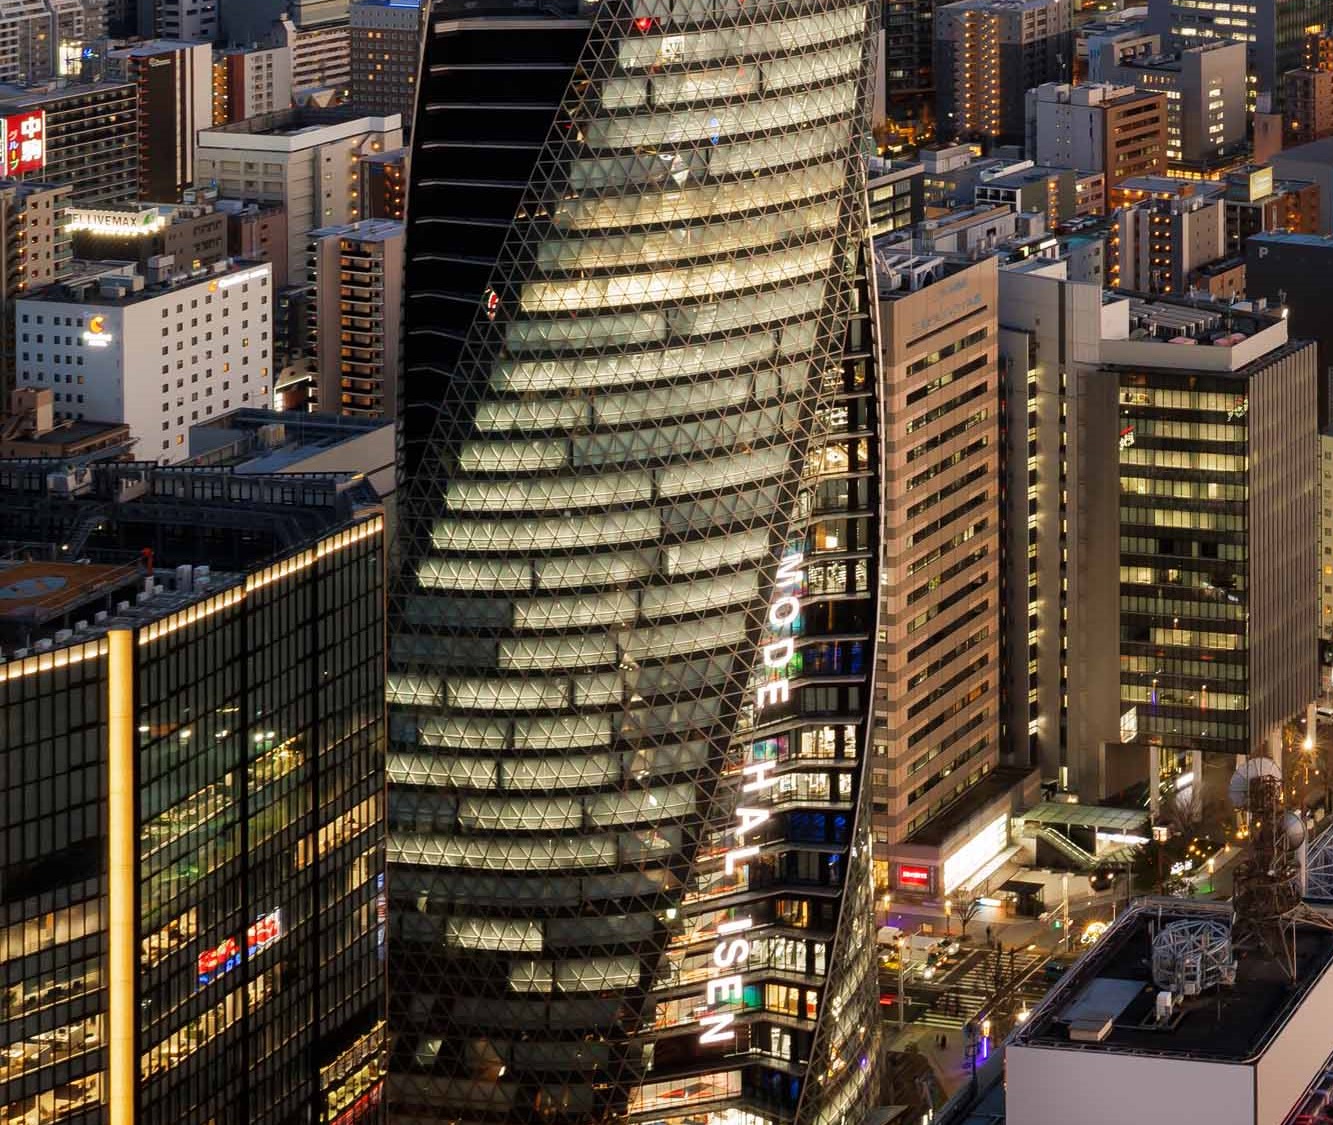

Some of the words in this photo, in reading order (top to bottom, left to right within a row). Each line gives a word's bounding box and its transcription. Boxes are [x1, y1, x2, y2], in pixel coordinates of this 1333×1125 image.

[8, 129, 19, 171] グループ
[87, 214, 137, 226] LIVEMAX
[1258, 246, 1269, 259] P
[756, 552, 804, 709] MODE
[724, 760, 778, 876] HAL
[699, 918, 753, 1045] ISEN
